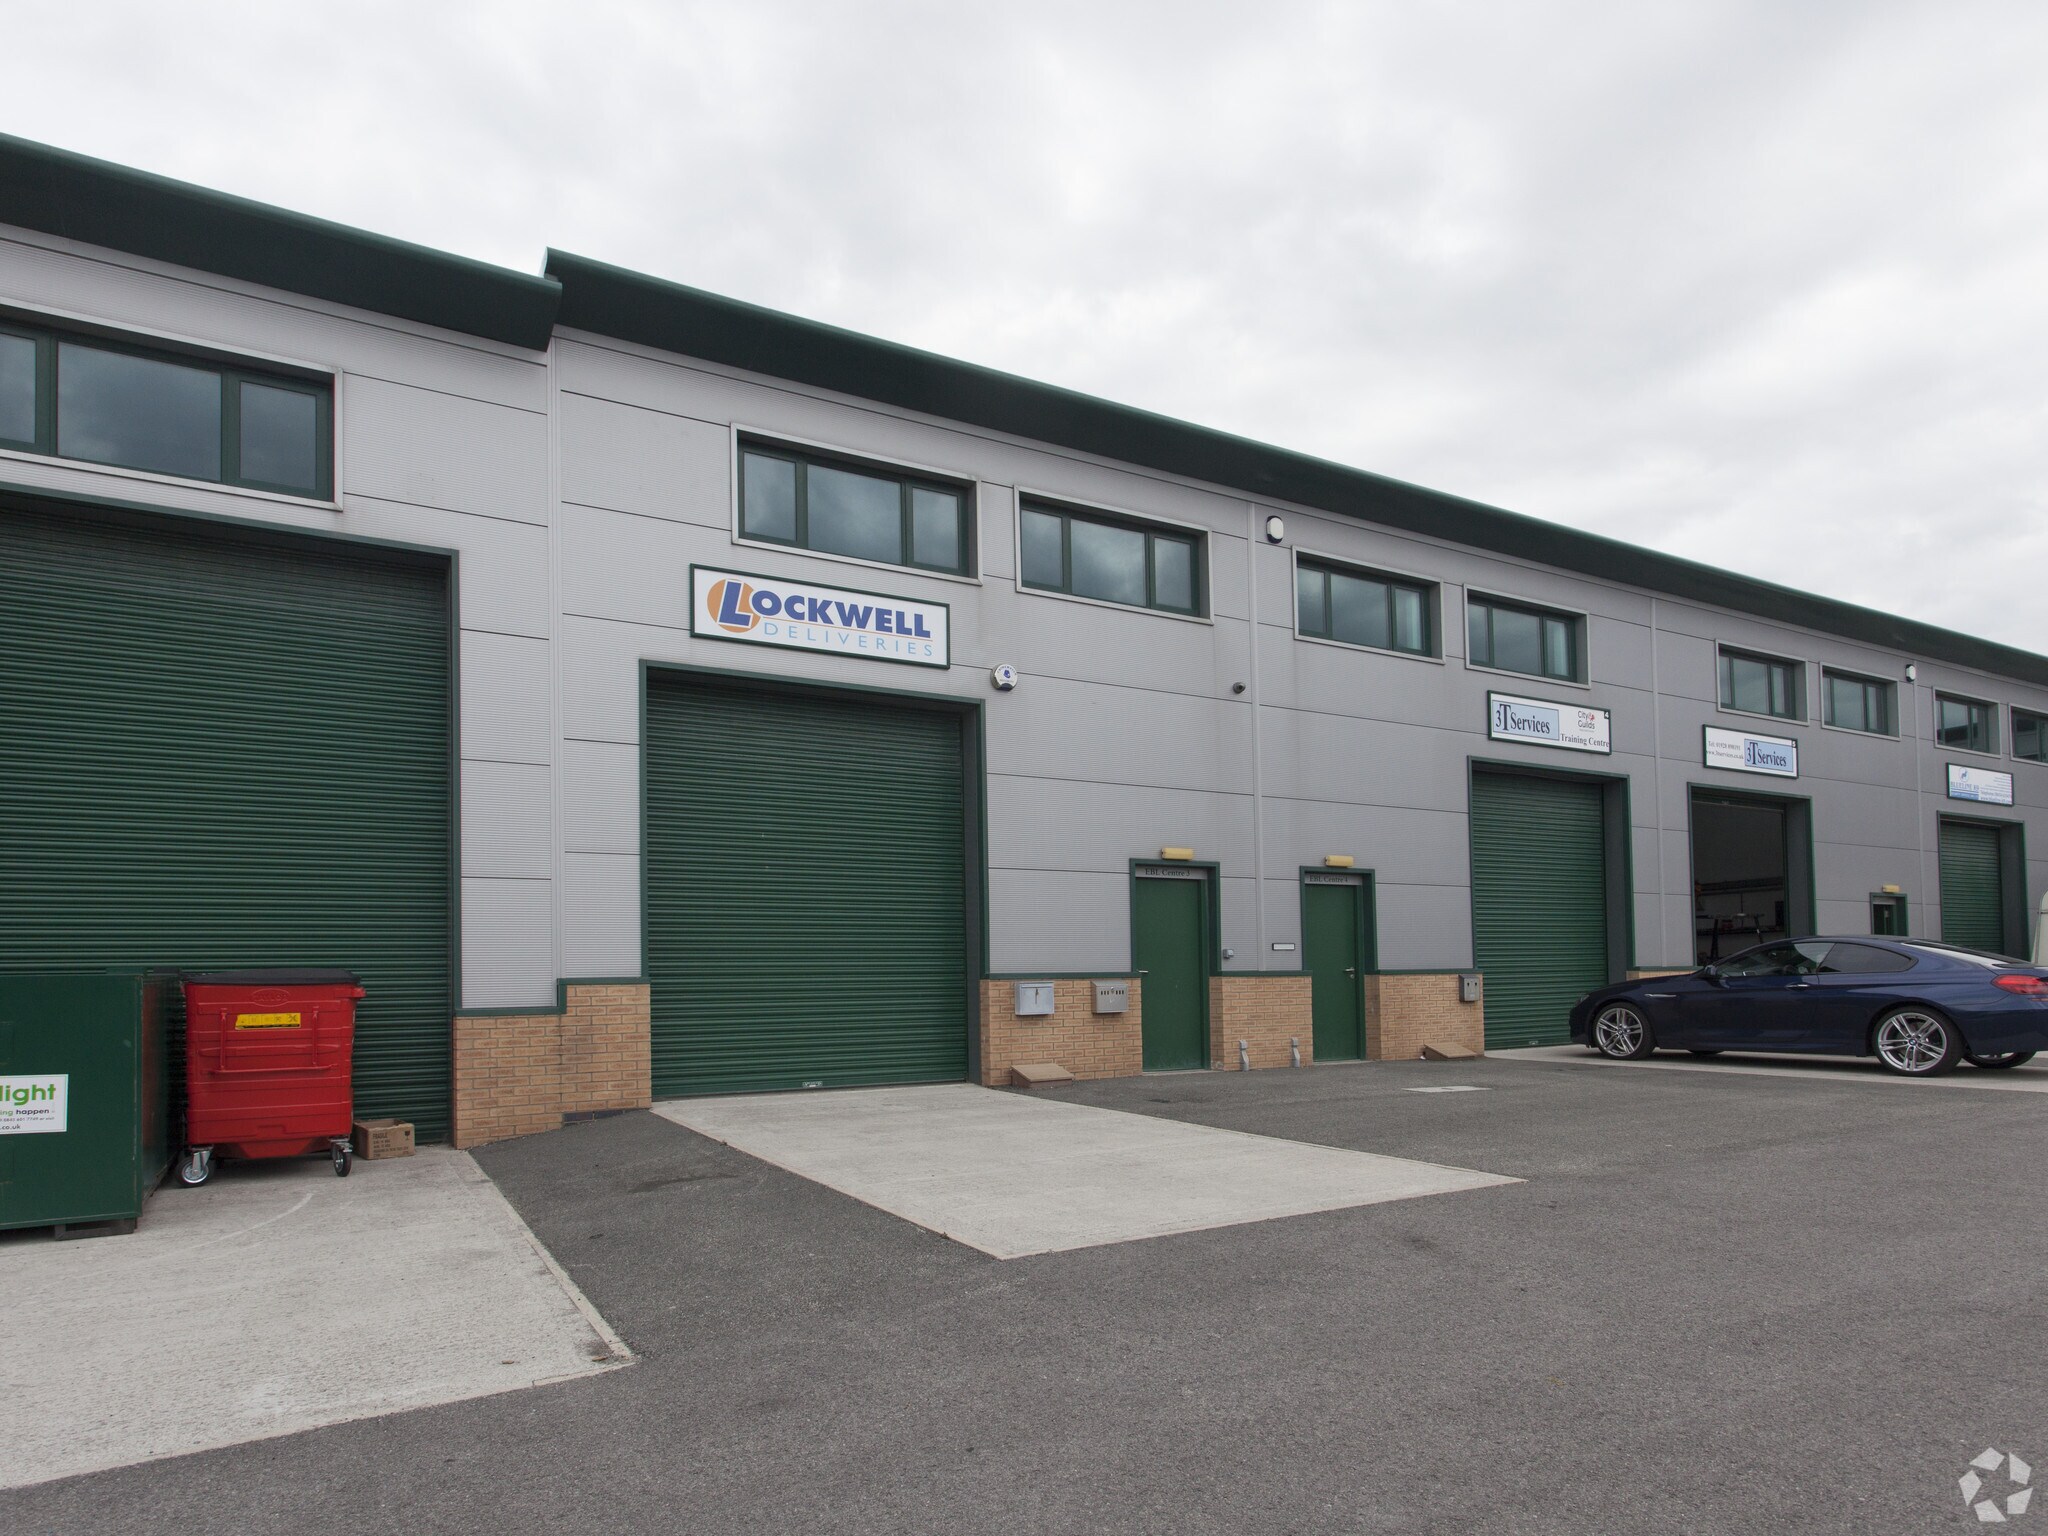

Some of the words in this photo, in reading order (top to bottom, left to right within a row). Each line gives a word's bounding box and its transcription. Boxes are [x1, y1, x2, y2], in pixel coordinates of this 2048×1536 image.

[718, 581, 931, 639] LOCKWELL
[764, 622, 933, 657] DELIVERIES
[1560, 733, 1587, 746] Training
[1145, 868, 1160, 876] EBL
[1161, 868, 1185, 877] Centre
[1323, 875, 1344, 883] Centre
